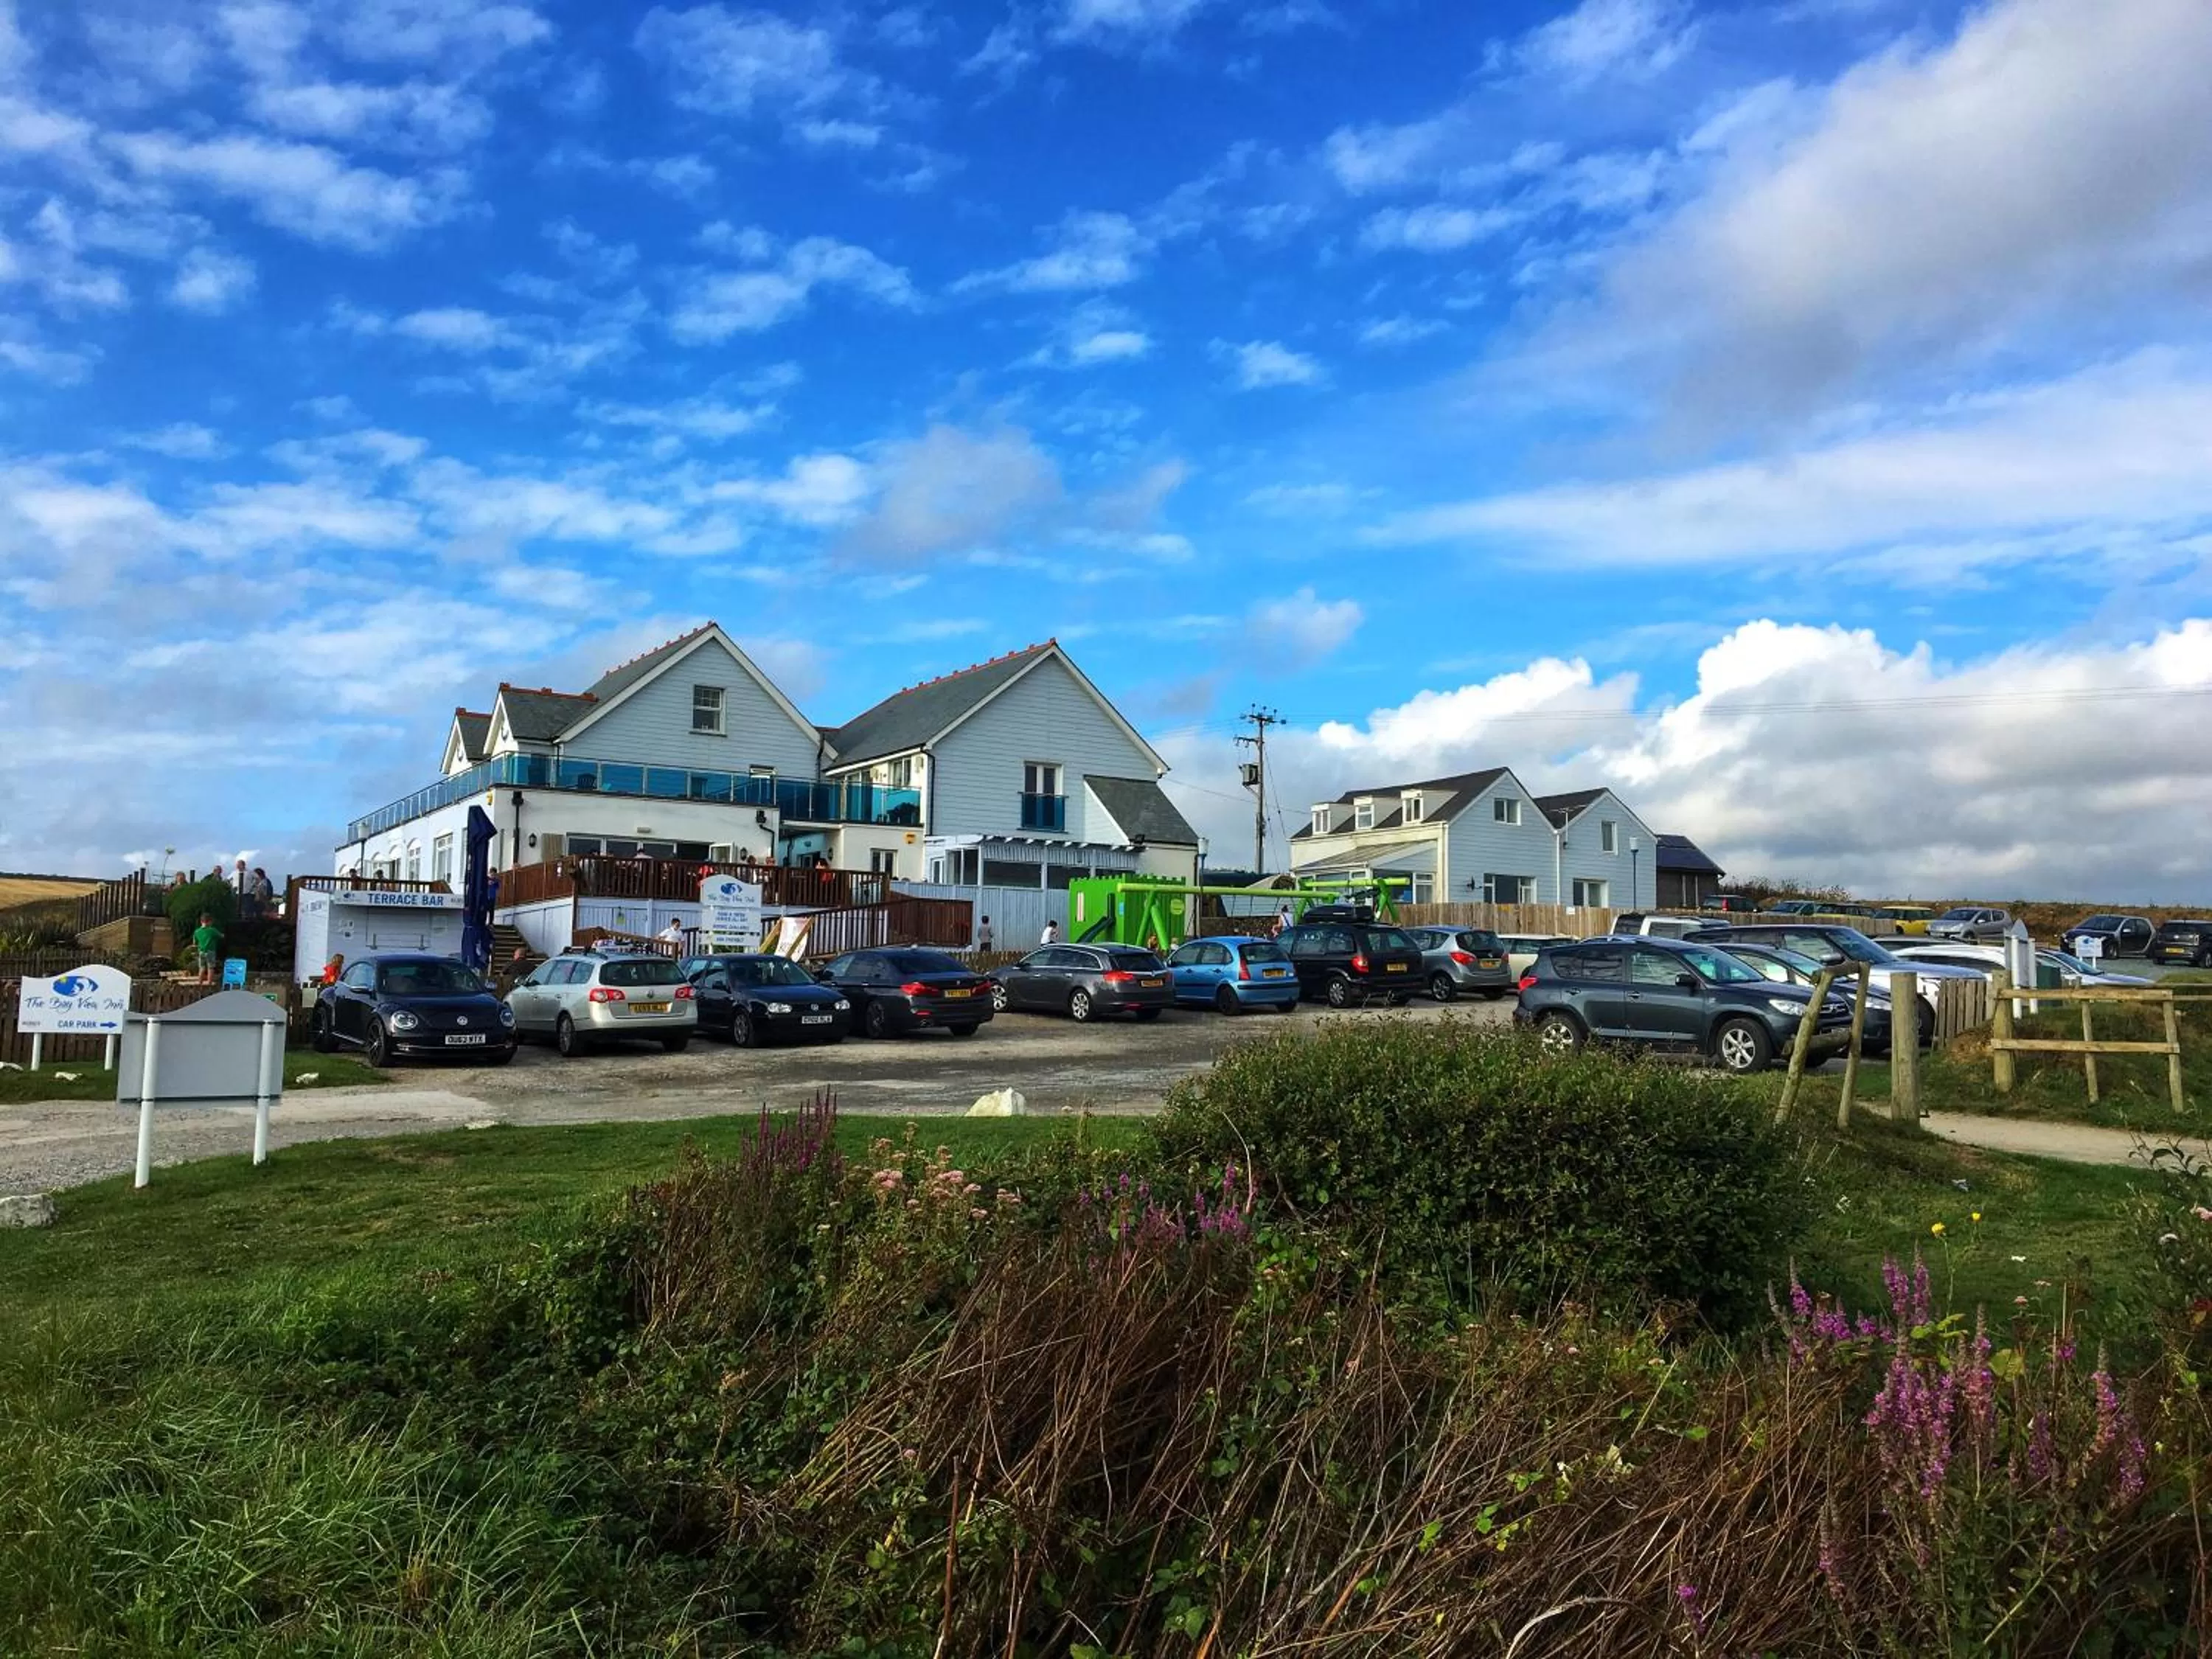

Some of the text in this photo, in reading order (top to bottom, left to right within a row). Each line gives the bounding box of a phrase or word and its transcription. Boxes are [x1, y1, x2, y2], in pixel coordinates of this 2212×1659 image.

[367, 893, 417, 905] TERRACE
[422, 894, 444, 905] BAR
[24, 997, 43, 1009] The
[50, 997, 73, 1013] Bay
[77, 996, 97, 1010] View
[58, 1020, 97, 1029] CAR PARK
